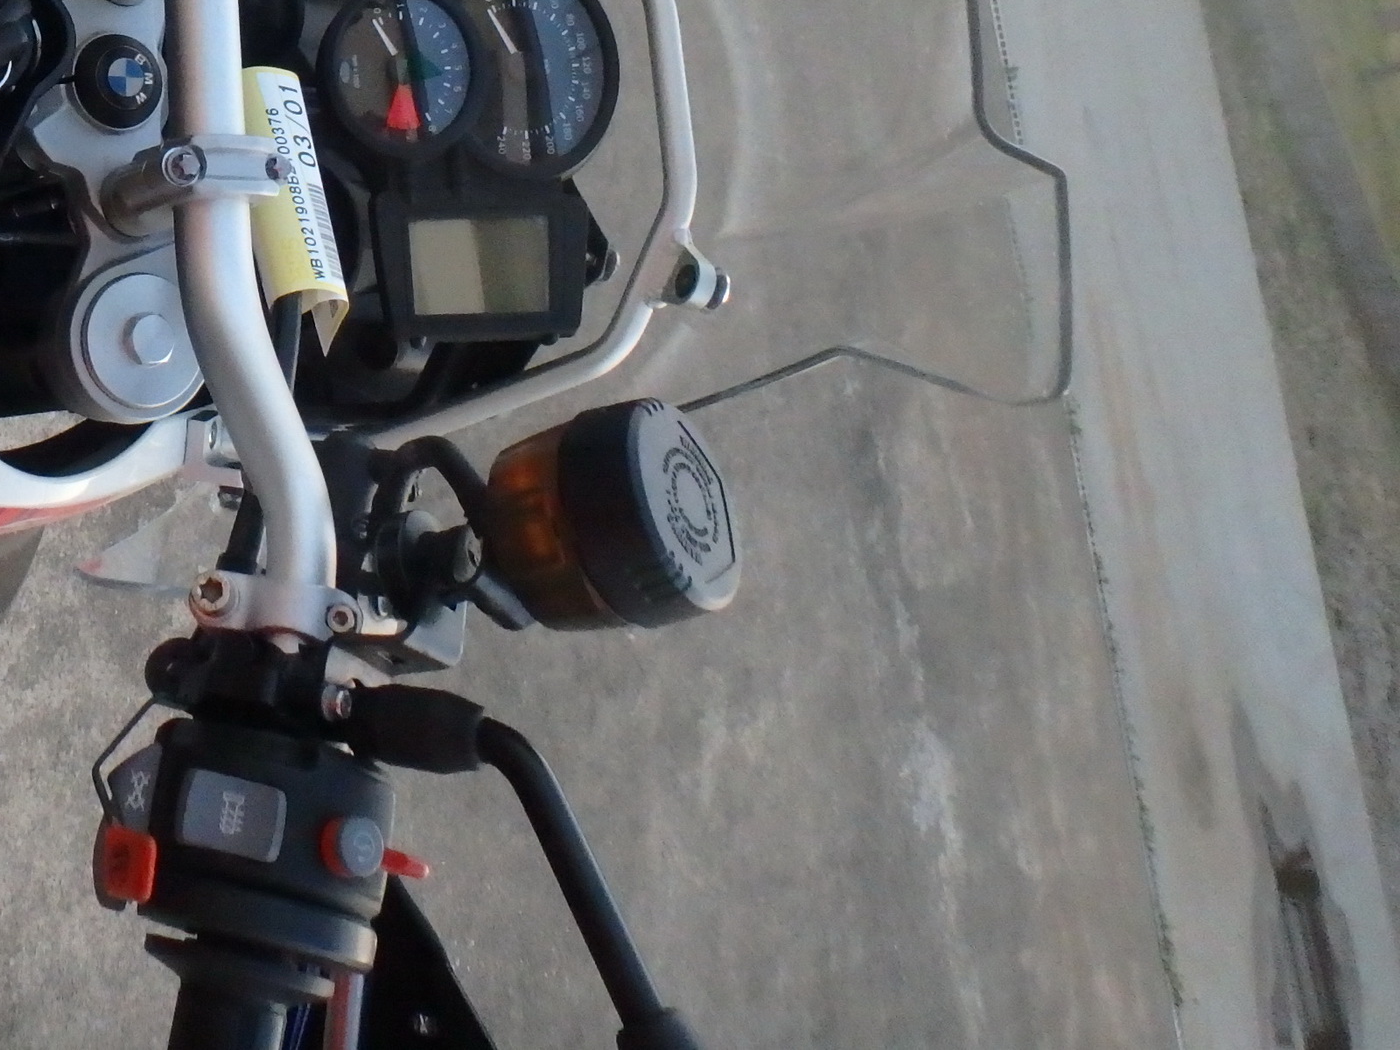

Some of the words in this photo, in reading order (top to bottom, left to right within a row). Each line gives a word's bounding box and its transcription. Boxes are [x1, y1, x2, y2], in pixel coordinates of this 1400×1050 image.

[582, 57, 592, 74] 120
[133, 54, 154, 104] BMW
[581, 82, 591, 99] 140
[575, 105, 584, 122] 160
[278, 85, 316, 168] 03/01
[563, 123, 572, 140] 180
[497, 136, 506, 154] 240
[522, 141, 531, 160] 220
[546, 136, 555, 154] 200
[265, 108, 326, 280] WB1021908B00376
